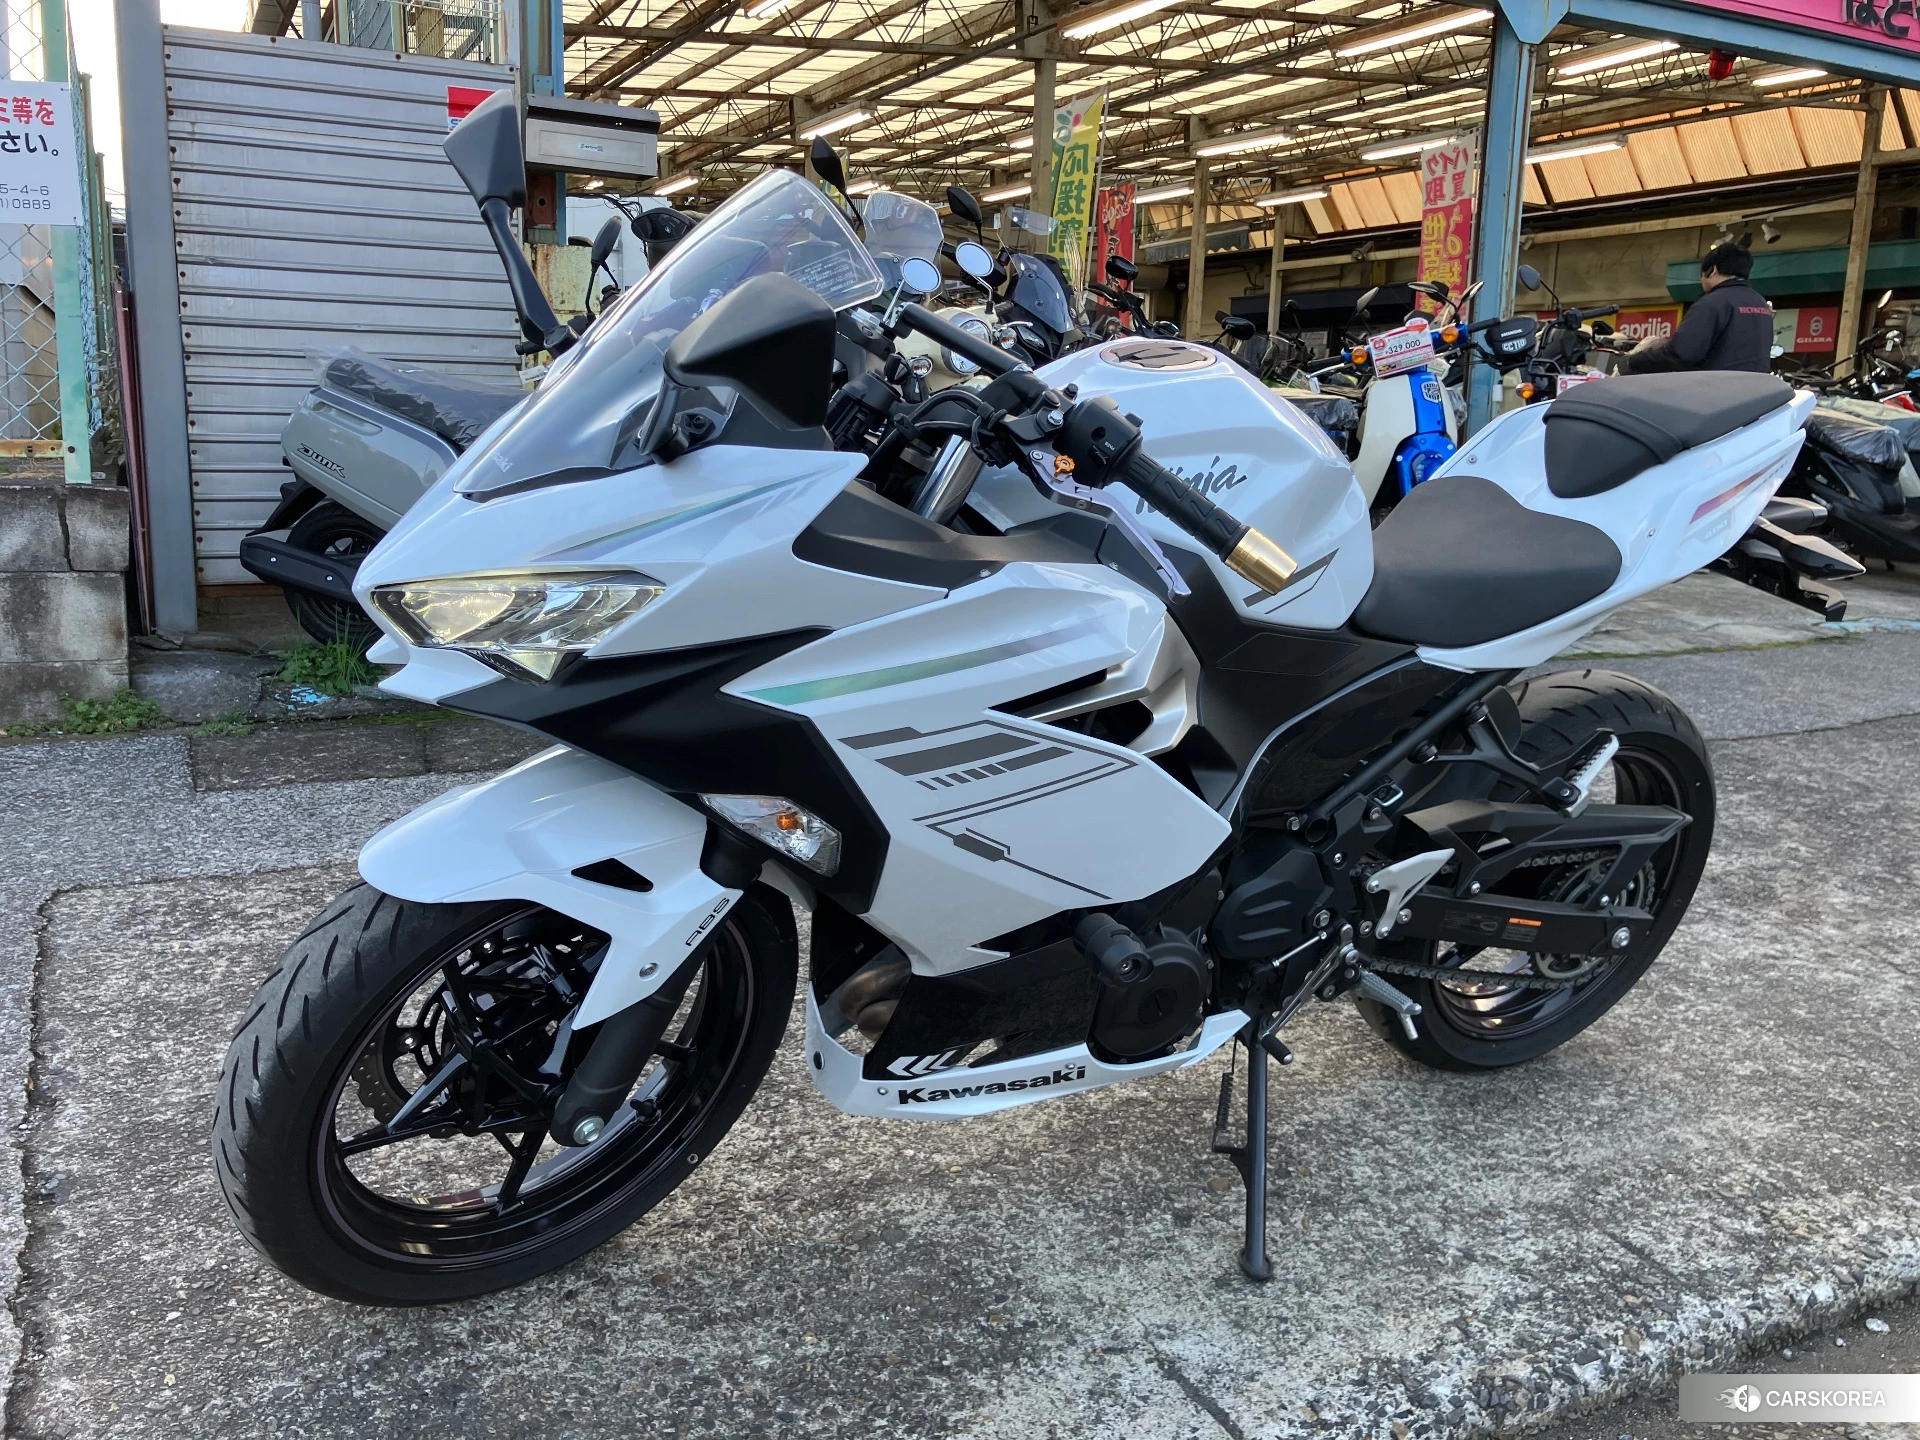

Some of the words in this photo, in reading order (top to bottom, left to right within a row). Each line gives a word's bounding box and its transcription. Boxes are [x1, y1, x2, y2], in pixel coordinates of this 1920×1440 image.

[0, 131, 59, 156] さい。
[1619, 317, 1672, 339] aprilia
[1796, 336, 1833, 344] GILERA
[685, 897, 730, 947] ABS
[898, 1065, 1087, 1105] Kawasaki
